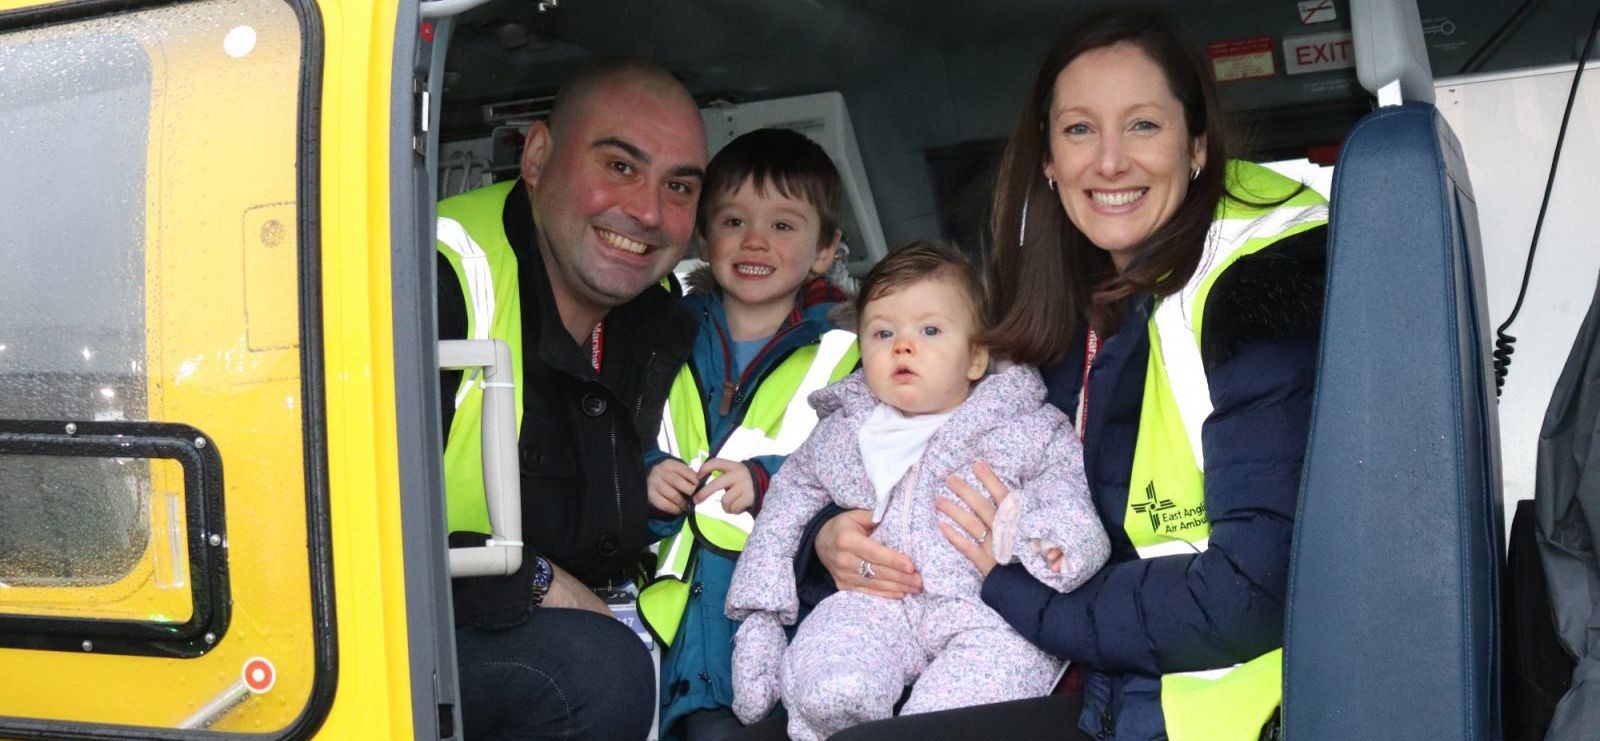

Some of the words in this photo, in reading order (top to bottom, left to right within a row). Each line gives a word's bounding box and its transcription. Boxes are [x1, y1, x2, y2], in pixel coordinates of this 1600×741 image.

[1295, 40, 1351, 66] EXIT
[1162, 511, 1182, 522] East
[1165, 524, 1178, 534] Air
